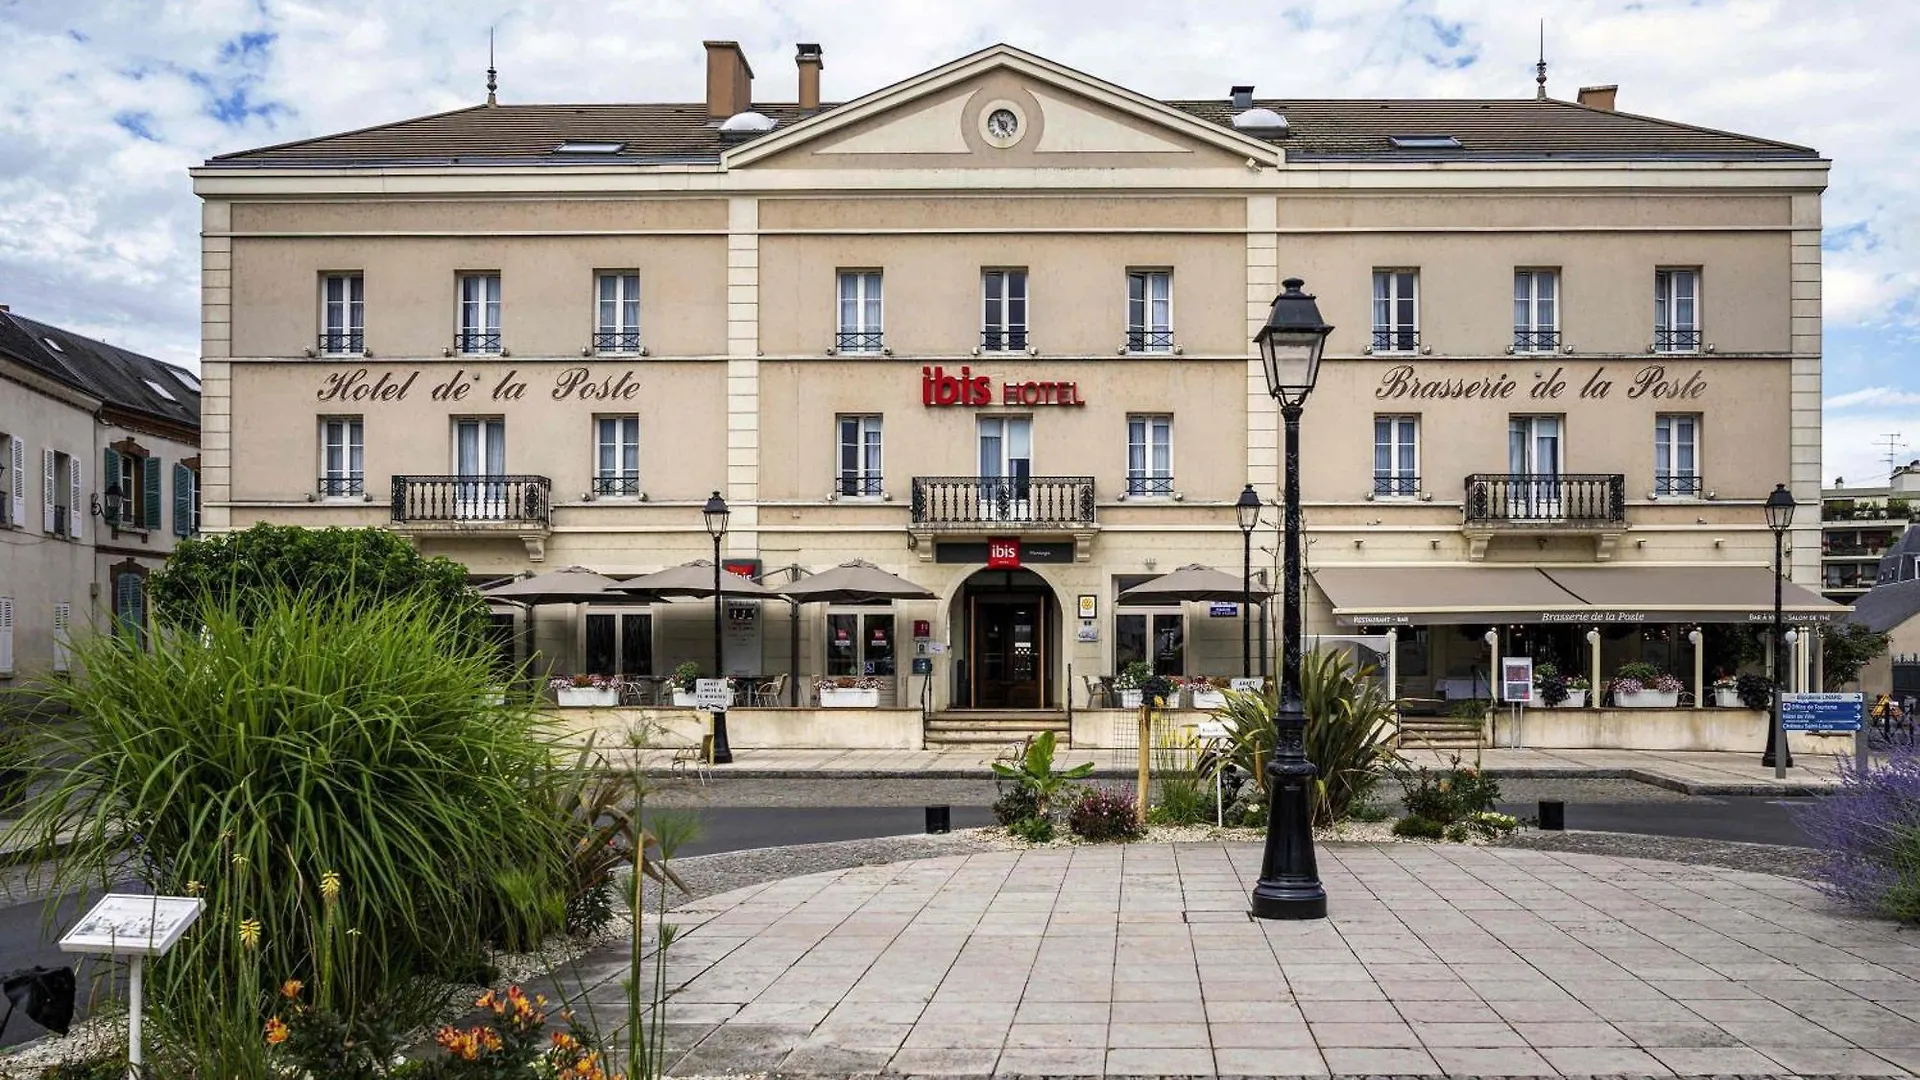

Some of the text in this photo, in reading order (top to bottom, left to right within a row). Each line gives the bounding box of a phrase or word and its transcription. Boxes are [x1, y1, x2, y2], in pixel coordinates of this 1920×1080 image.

[431, 370, 470, 400] de
[492, 370, 527, 400] la
[552, 367, 641, 400] Poste
[922, 366, 1085, 406] ibis HOTEL
[1375, 364, 1708, 400] Brasserie de la Poste
[992, 544, 1016, 558] ibis
[1541, 612, 1645, 621] Brasserie de la Poste
